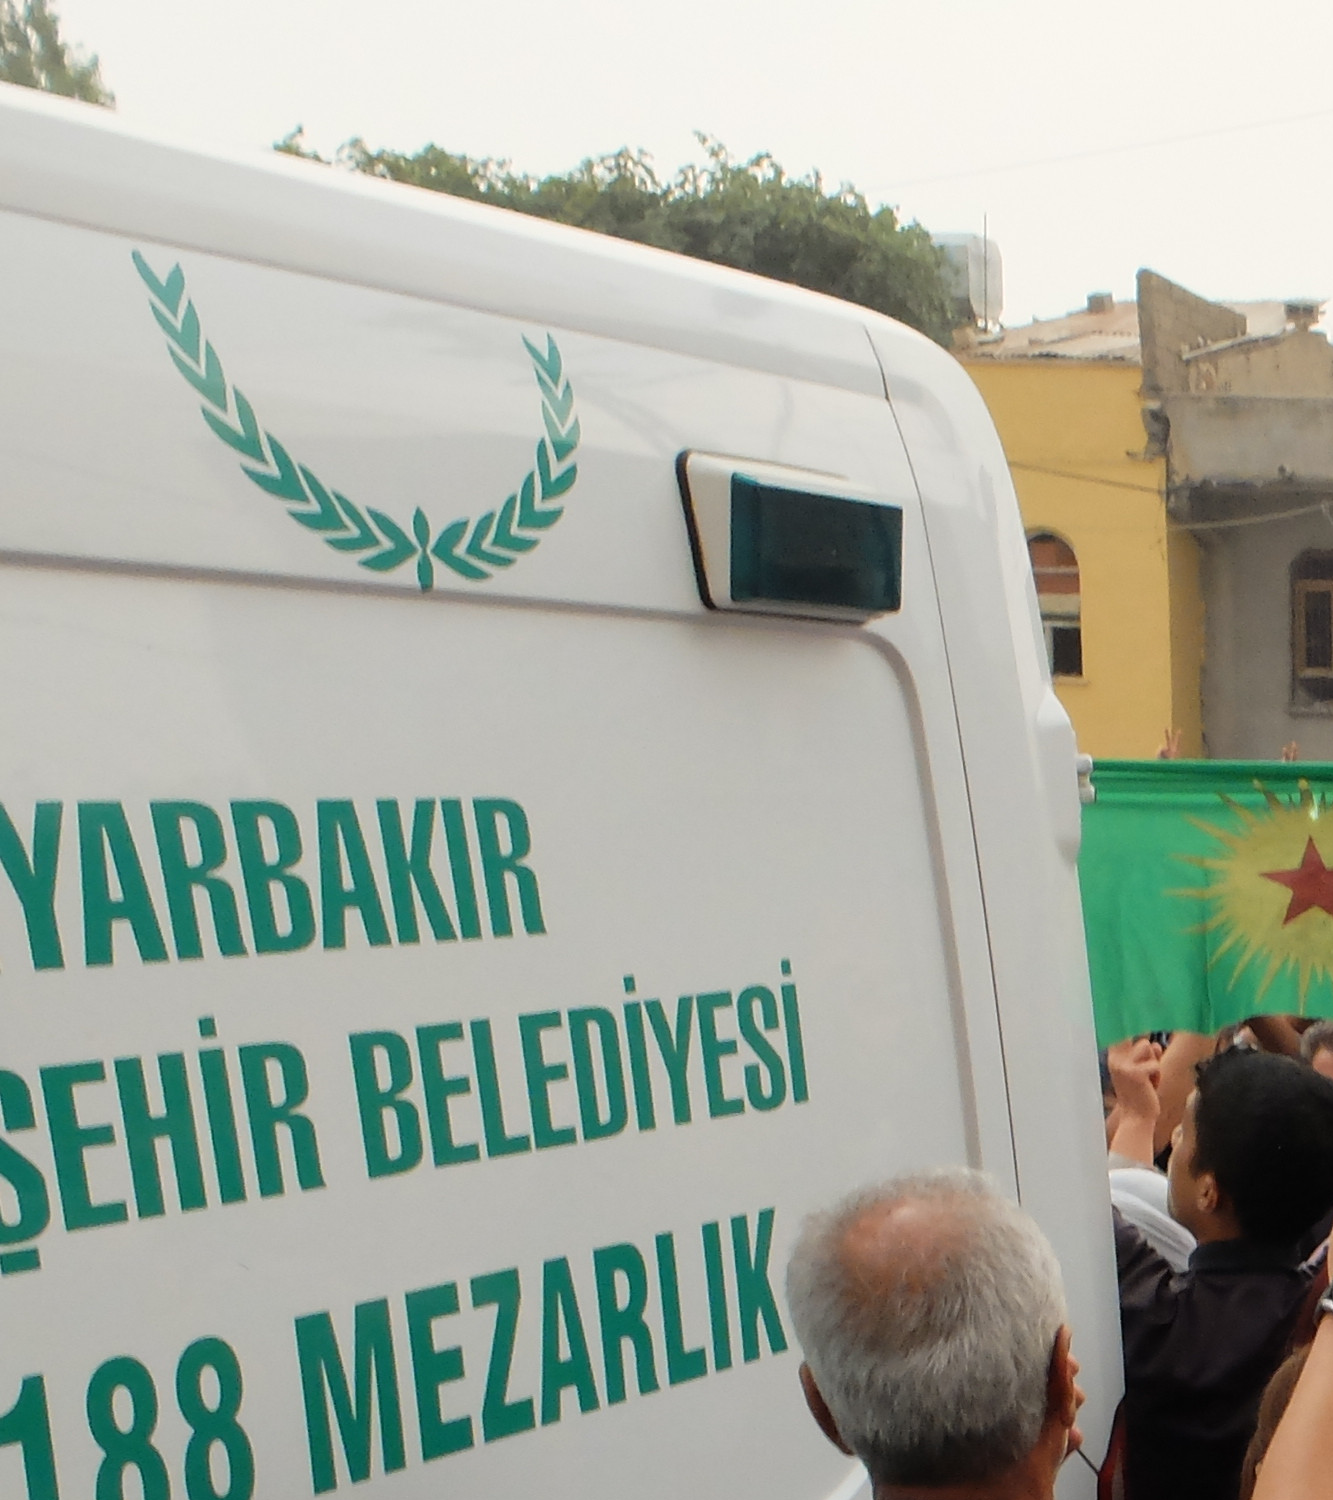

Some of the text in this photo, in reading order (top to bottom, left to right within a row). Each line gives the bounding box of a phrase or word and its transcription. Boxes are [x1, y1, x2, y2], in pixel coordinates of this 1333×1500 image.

[0, 798, 547, 971] YARBAKIR
[347, 957, 809, 1179] BELEDİYESİ
[294, 1206, 788, 1496] MEZARLIK
